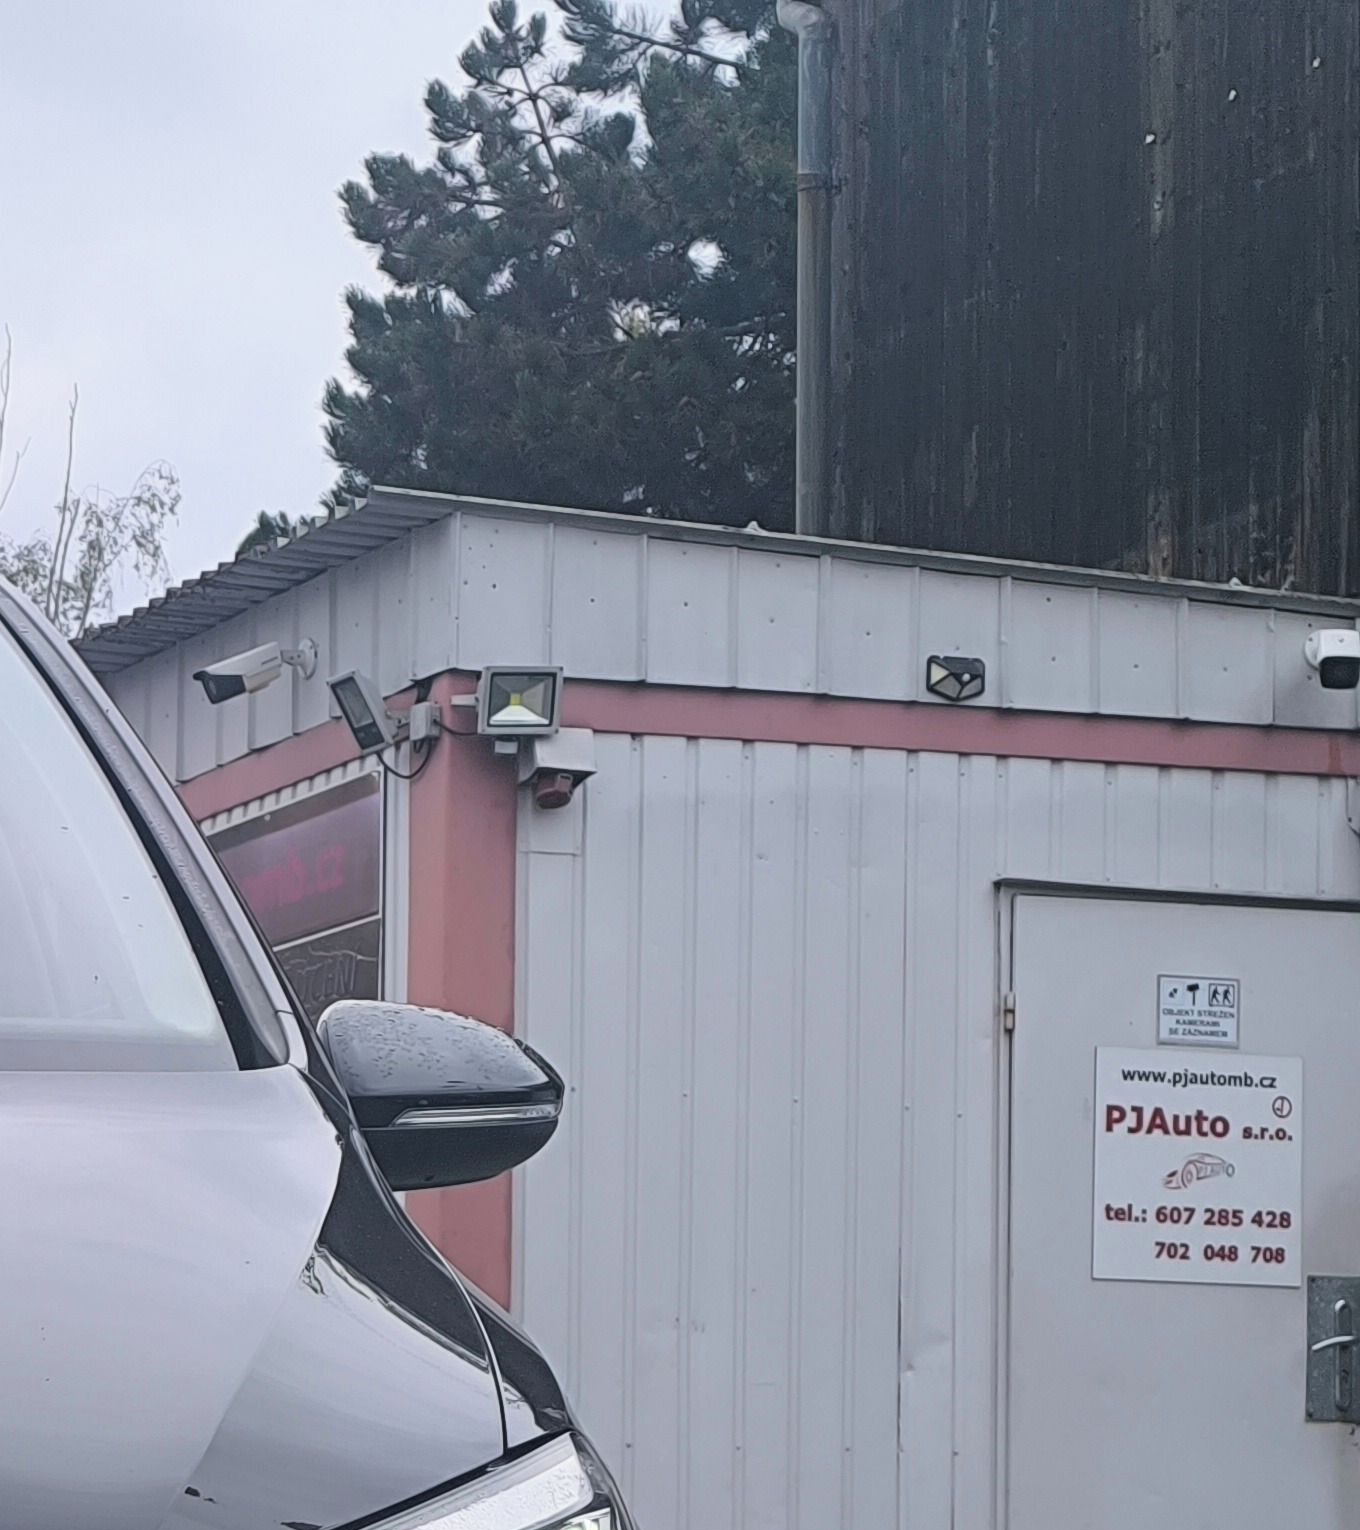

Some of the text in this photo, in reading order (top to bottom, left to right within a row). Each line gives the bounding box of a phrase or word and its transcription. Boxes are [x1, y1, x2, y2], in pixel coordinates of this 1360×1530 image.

[1121, 1067, 1278, 1089] www.pjautomb.cz
[1104, 1103, 1294, 1142] PJAuto s.r.o.
[1104, 1203, 1293, 1230] tel.: 607 285 428
[1153, 1241, 1287, 1266] 702 048 708
